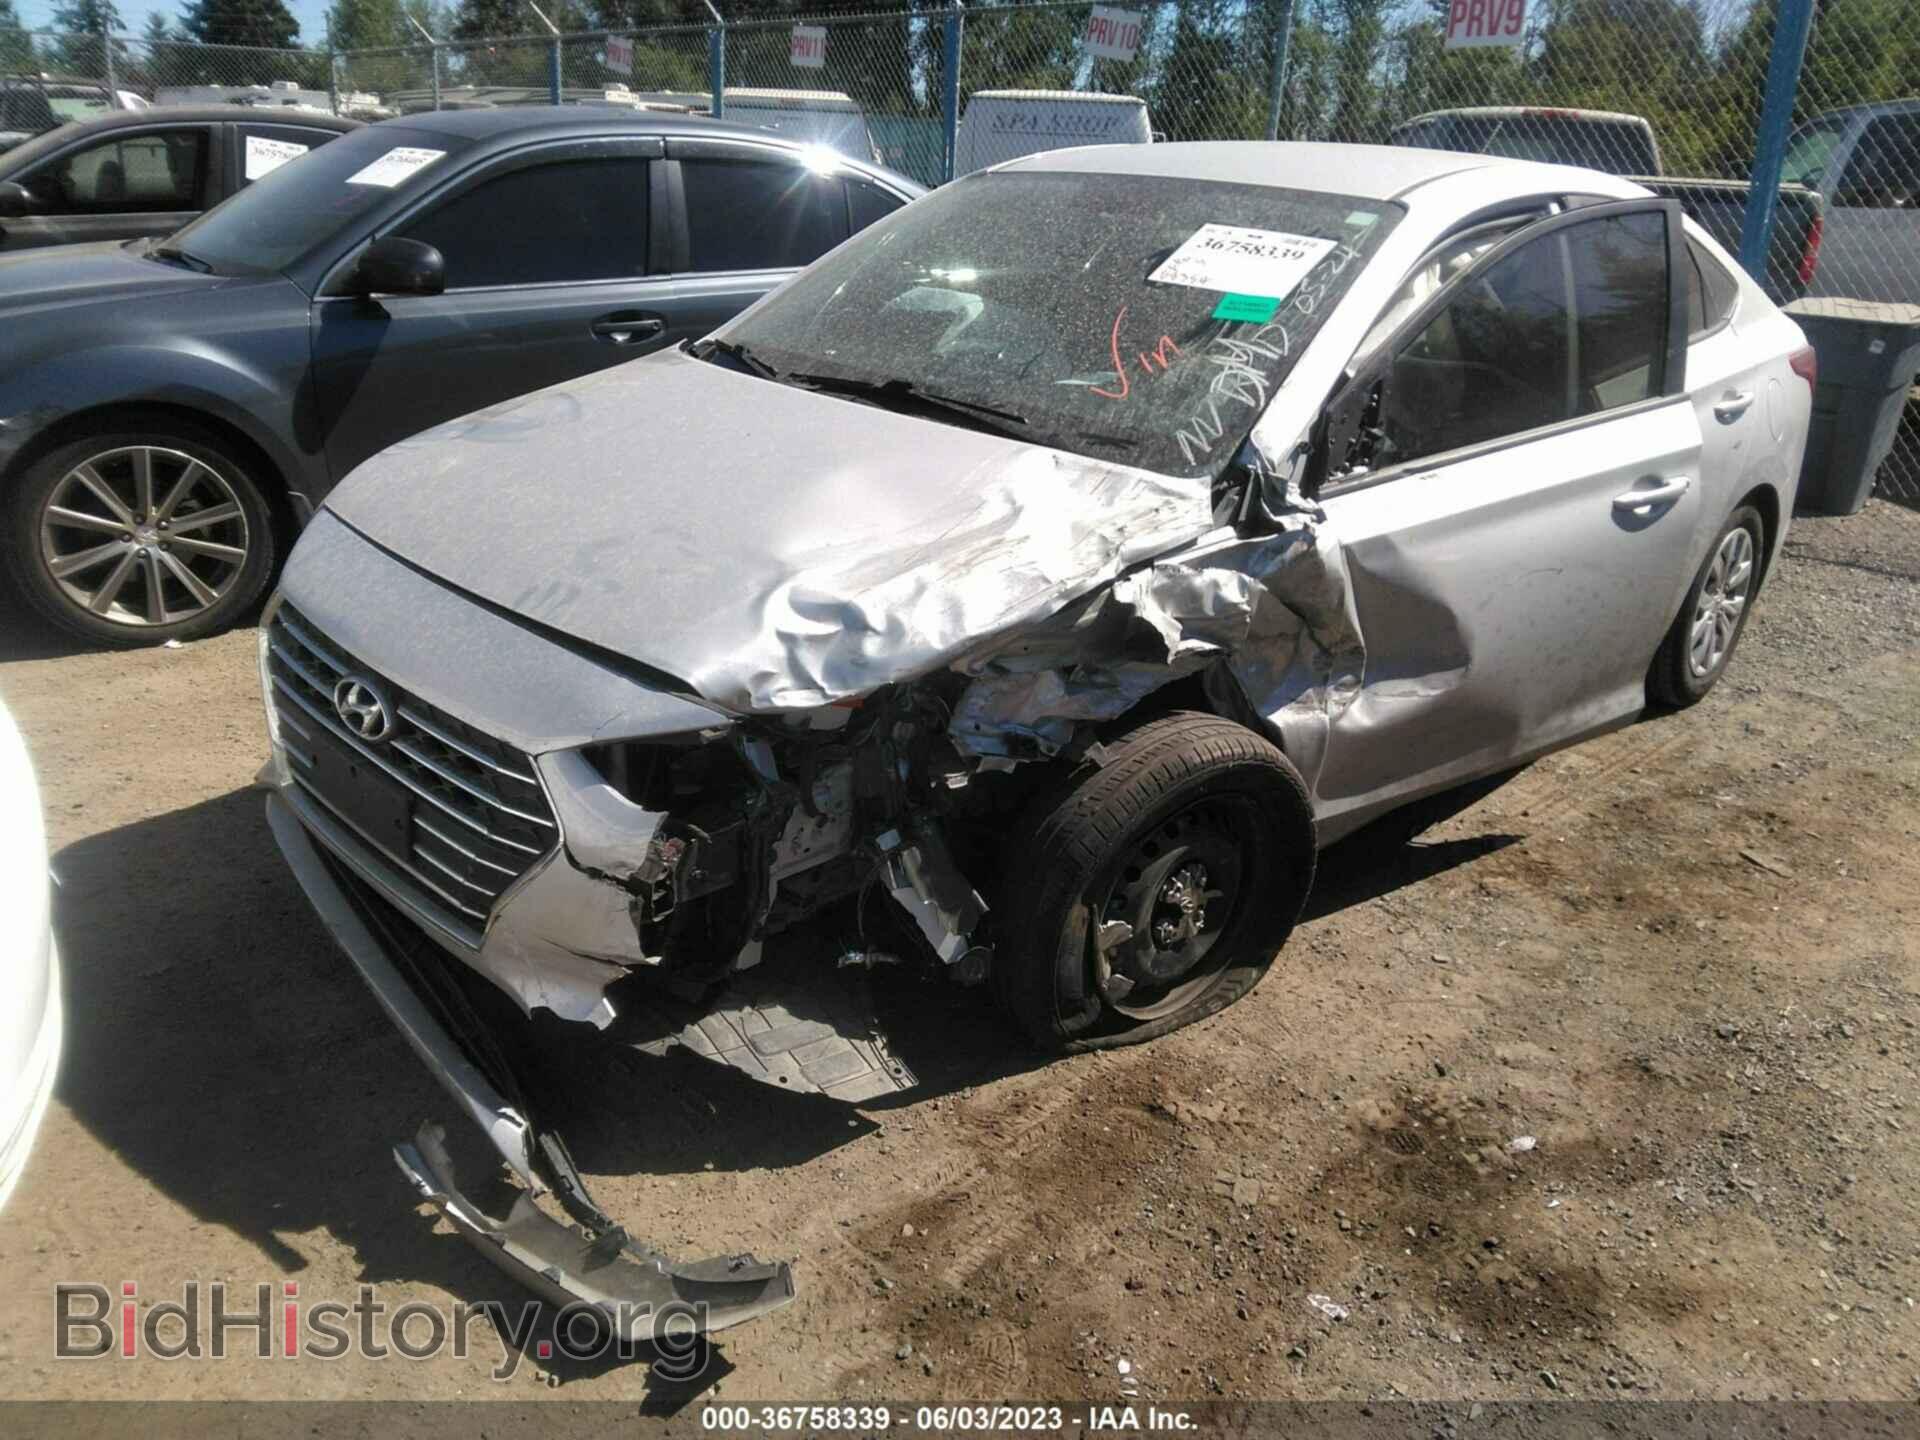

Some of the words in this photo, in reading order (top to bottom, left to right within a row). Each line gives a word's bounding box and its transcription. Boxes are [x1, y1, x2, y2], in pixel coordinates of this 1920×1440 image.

[1448, 0, 1526, 38] PRV9
[992, 112, 1038, 131] SPA
[1196, 237, 1306, 261] 36758339
